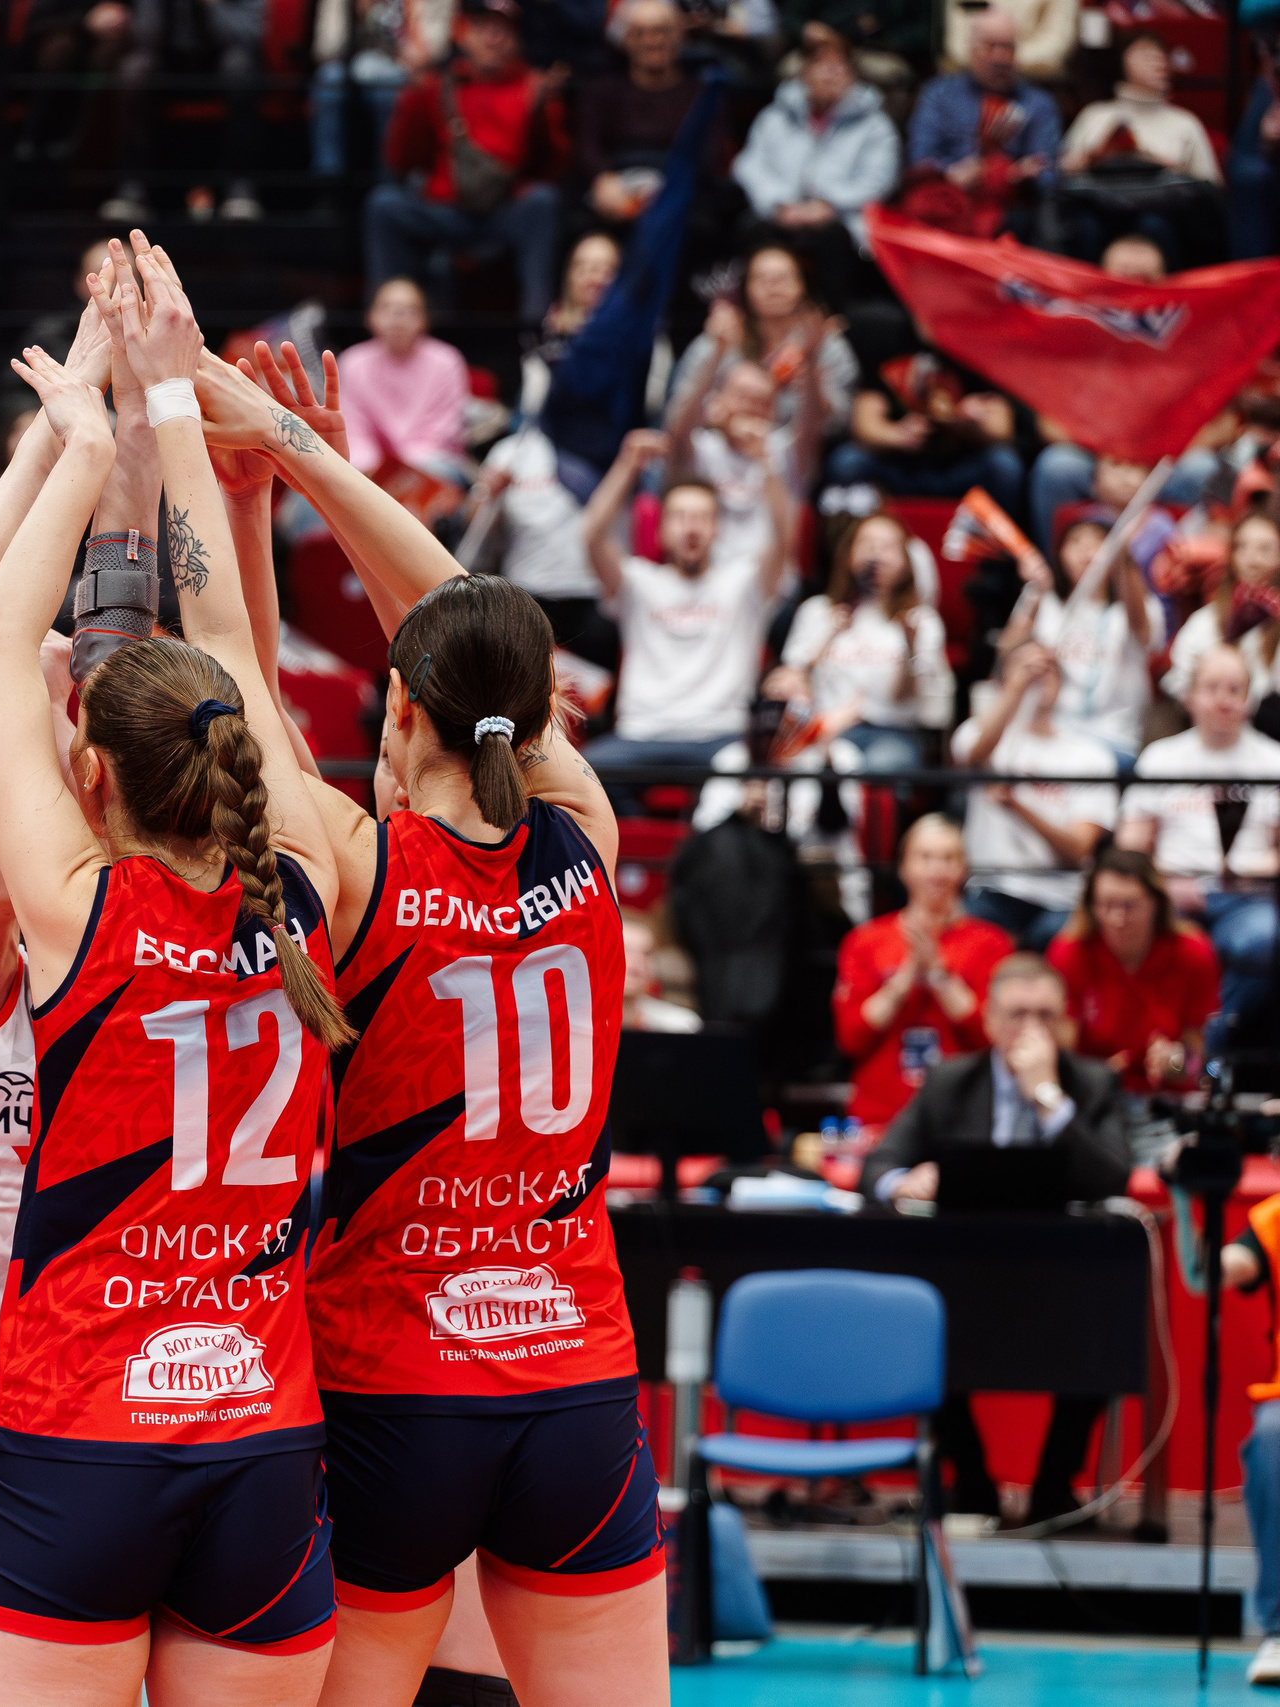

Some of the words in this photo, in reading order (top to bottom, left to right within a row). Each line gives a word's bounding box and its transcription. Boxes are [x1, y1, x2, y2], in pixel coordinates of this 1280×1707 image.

[396, 860, 599, 934] ВЕЛИСЕВИЧ
[427, 943, 594, 1142] 10
[140, 988, 298, 1191] 12
[418, 1162, 593, 1209] ОМСКАЯ
[120, 1217, 293, 1261] ОМСКАЯ
[400, 1215, 594, 1257] ОБЛАСТЬ
[103, 1270, 290, 1312] ОБЛАСТЬ
[445, 1297, 560, 1331] СИБИРИ
[162, 1333, 243, 1358] БОГАТСТВО
[439, 1345, 529, 1362] ГЕНЕРАЛЬНЫЙ
[530, 1338, 586, 1356] СПОНСОР
[147, 1357, 257, 1392] СИБИРИ
[130, 1407, 218, 1425] ГЕНЕРАЛЬНЫЙ
[219, 1402, 272, 1422] СПОНСОР
